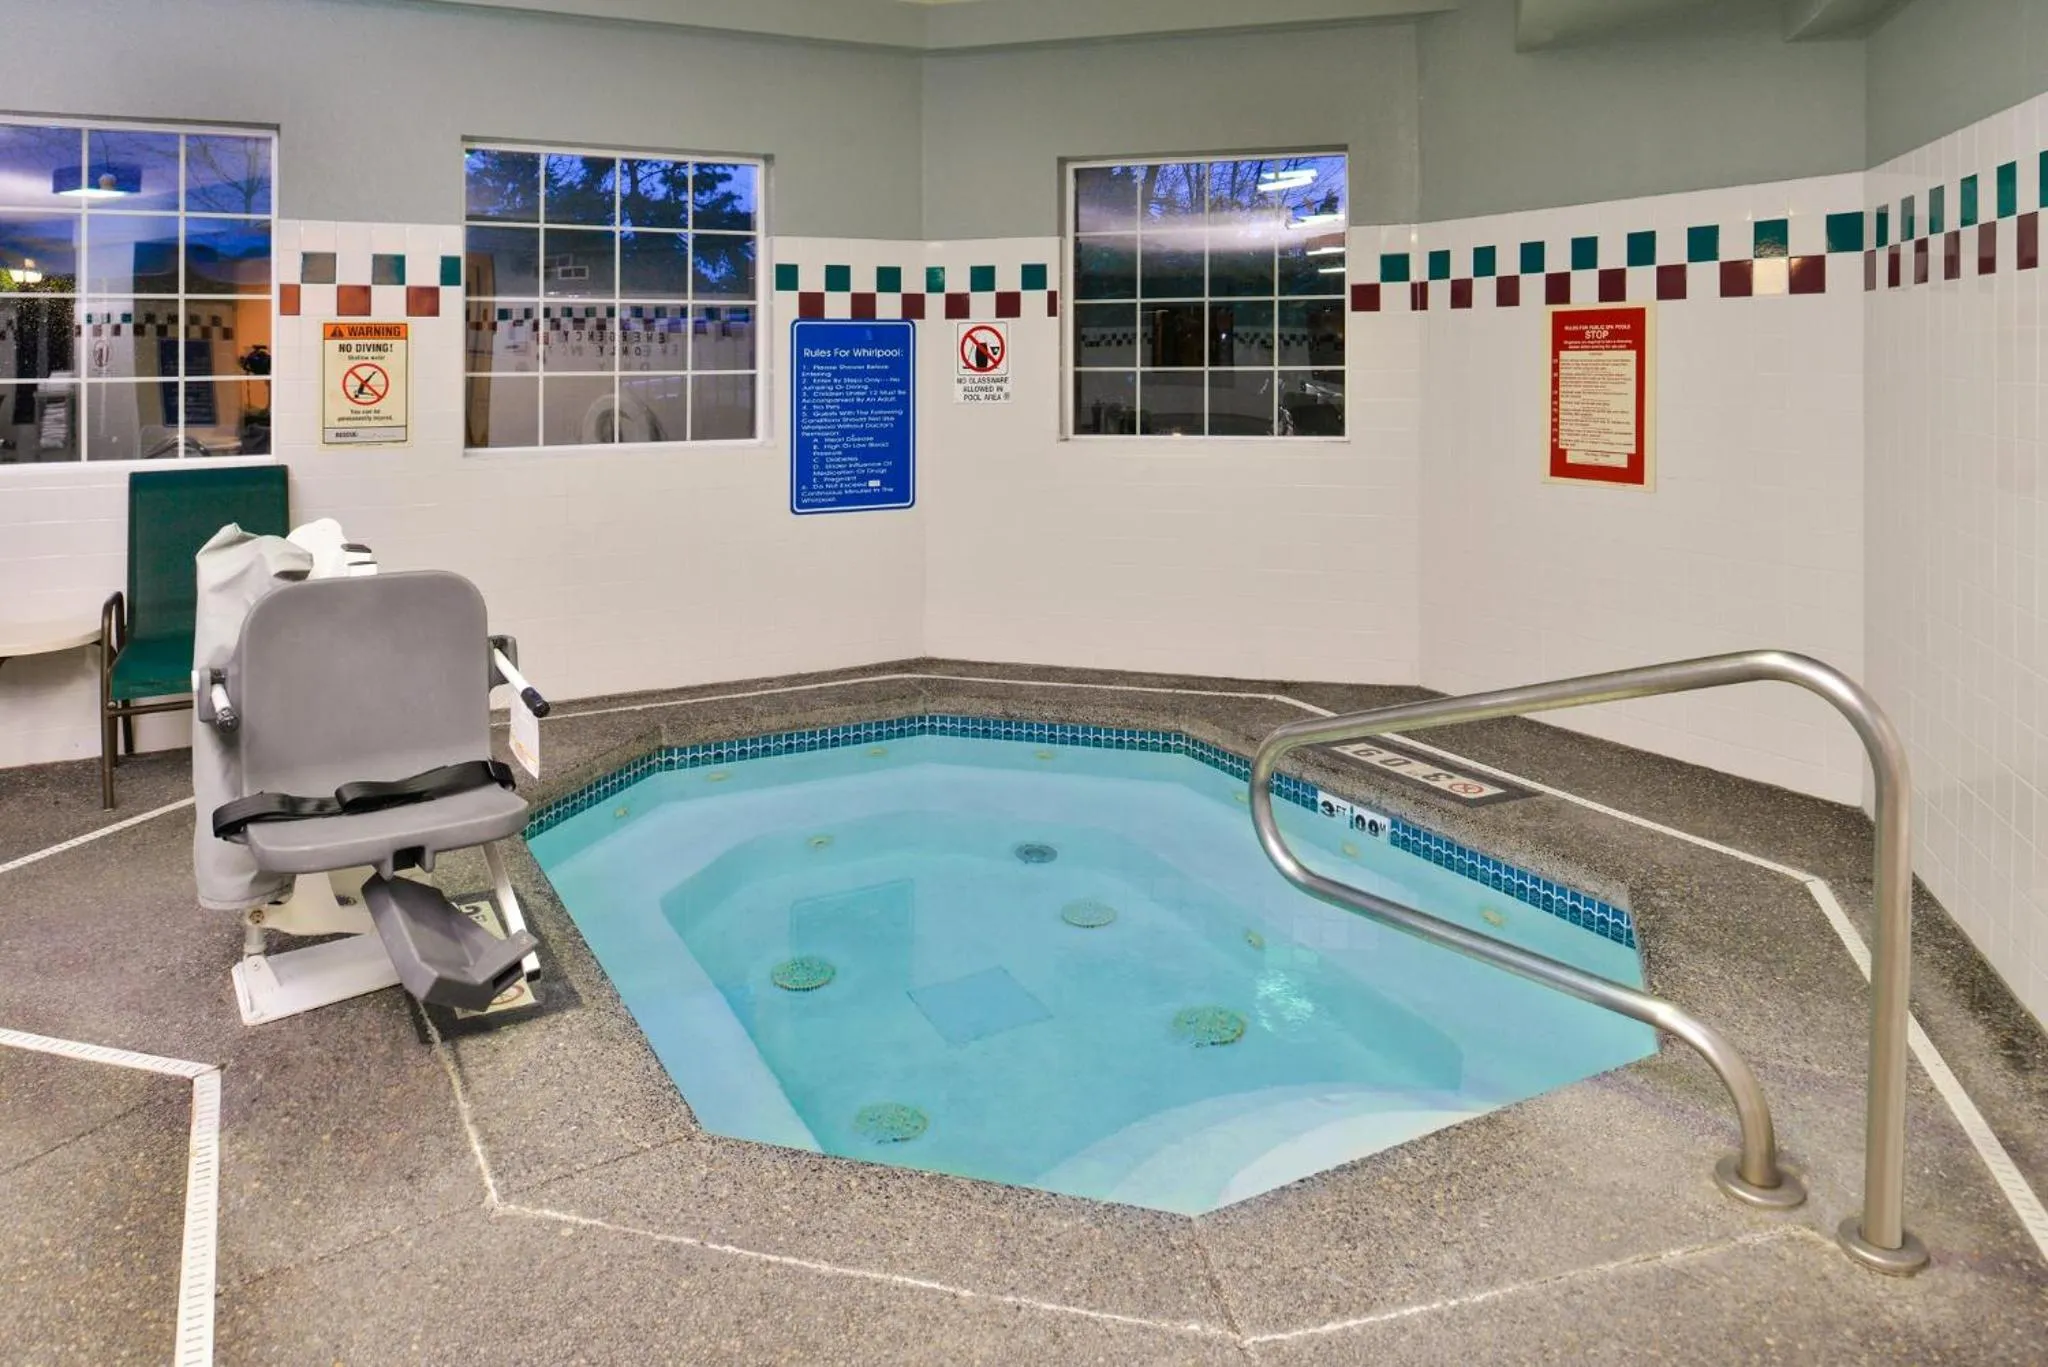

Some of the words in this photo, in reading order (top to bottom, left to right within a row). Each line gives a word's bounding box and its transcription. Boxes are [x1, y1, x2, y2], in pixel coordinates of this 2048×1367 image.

[347, 325, 401, 337] WARNING
[1584, 330, 1609, 339] STOP
[338, 343, 352, 353] NO
[355, 343, 393, 353] DIVING!
[803, 348, 832, 358] Rules
[833, 348, 850, 358] For
[969, 376, 1009, 384] GLASSWARE
